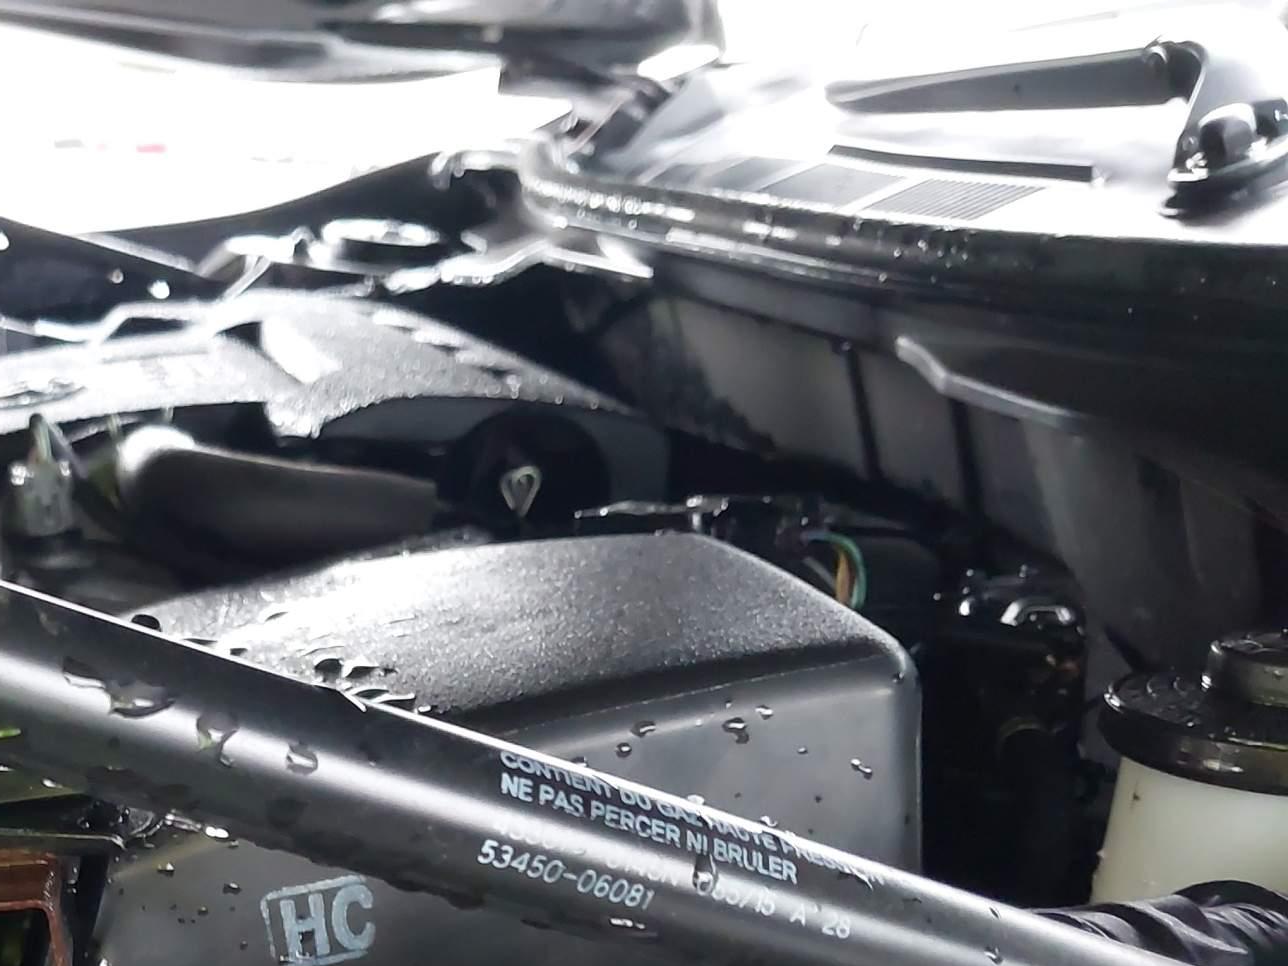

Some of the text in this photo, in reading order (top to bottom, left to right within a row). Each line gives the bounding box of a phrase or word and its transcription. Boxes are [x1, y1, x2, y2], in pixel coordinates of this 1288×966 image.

[501, 773, 533, 801] NE
[539, 785, 584, 817] PAS
[590, 800, 681, 848] PERCER
[686, 830, 708, 855] NI
[713, 838, 797, 885] BRULER
[619, 789, 651, 810] DU
[477, 839, 655, 910] 53450-06081
[280, 884, 376, 961] HC
